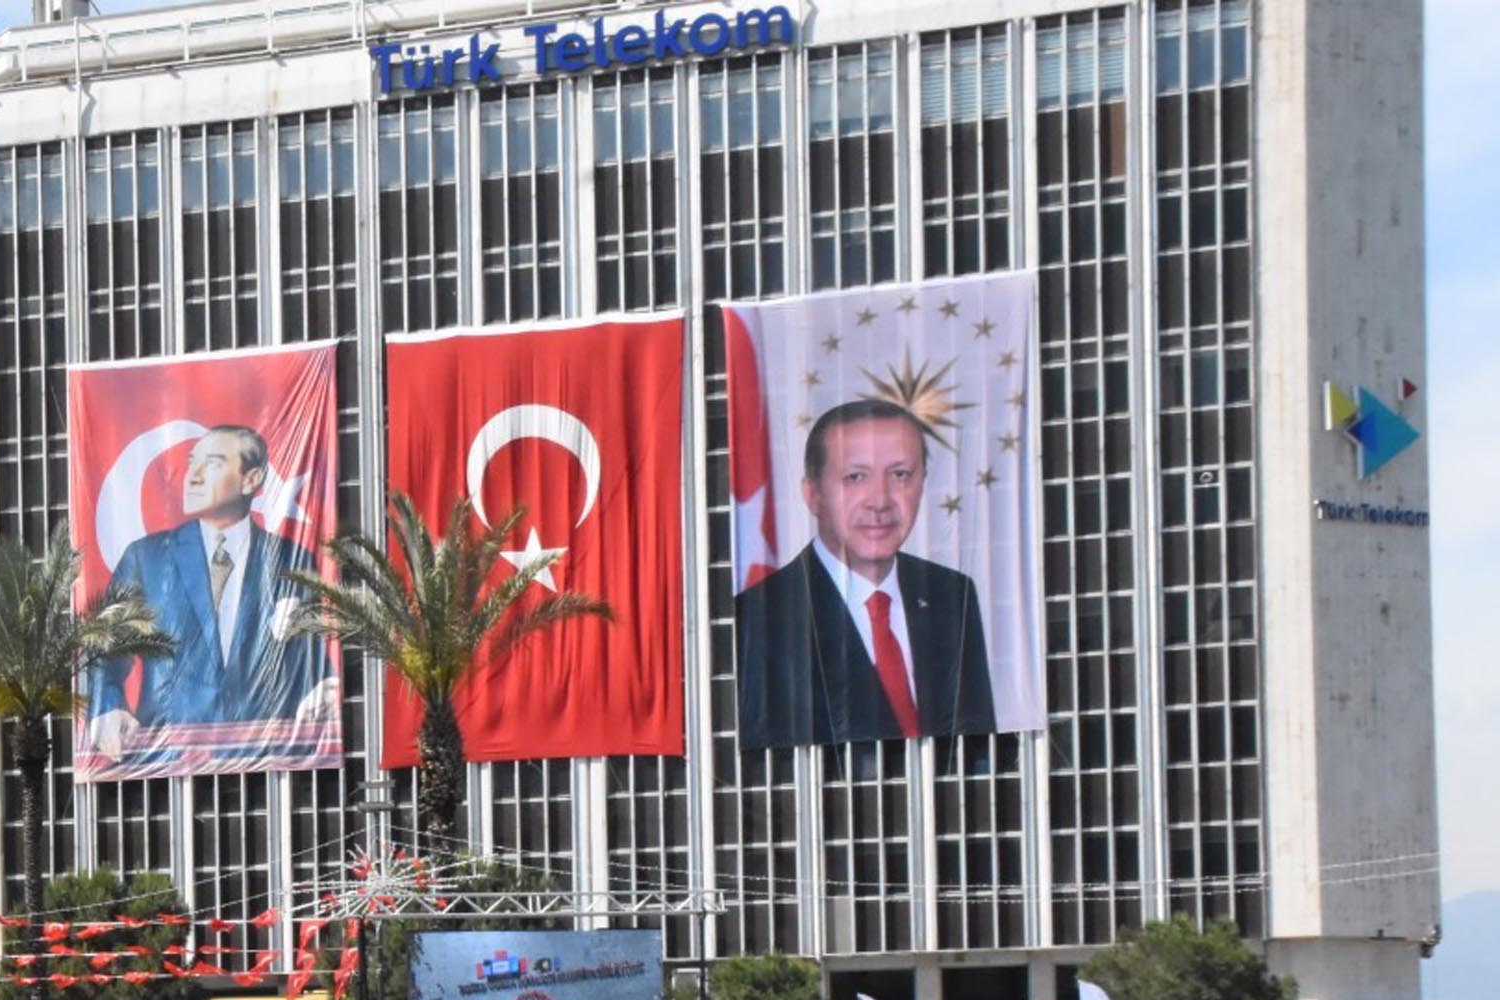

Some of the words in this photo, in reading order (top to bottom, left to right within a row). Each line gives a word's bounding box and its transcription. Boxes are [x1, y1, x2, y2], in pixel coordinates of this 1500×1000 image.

[369, 34, 501, 94] Türk
[525, 5, 792, 74] Telekom
[1313, 499, 1356, 519] Türk
[1359, 503, 1429, 527] Telekom
